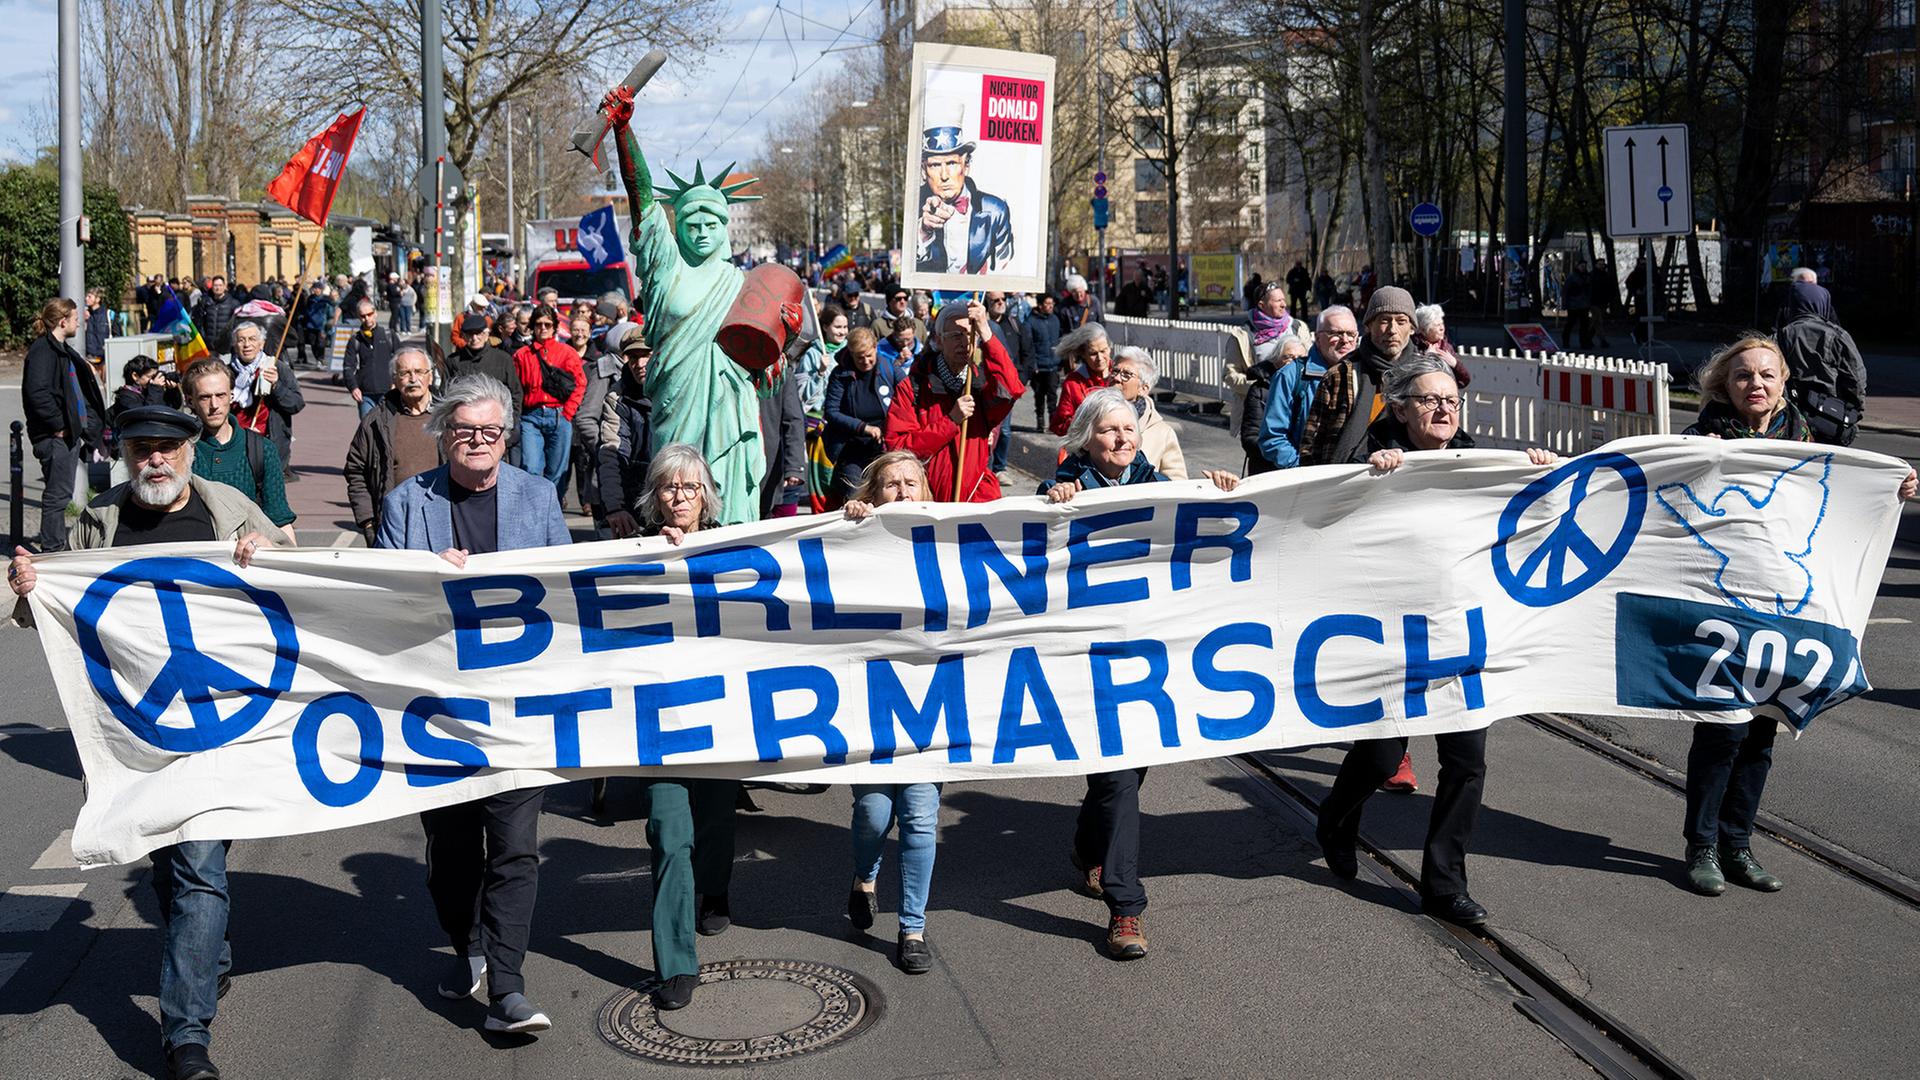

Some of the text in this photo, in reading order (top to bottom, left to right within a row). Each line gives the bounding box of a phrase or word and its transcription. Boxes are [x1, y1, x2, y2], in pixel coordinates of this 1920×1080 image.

[989, 80, 1039, 99] NICHT VOR
[988, 97, 1038, 121] DONALD
[987, 120, 1039, 142] DUCKEN.
[441, 501, 1260, 670] BERLINER
[292, 607, 1488, 807] OSTERMARSCH
